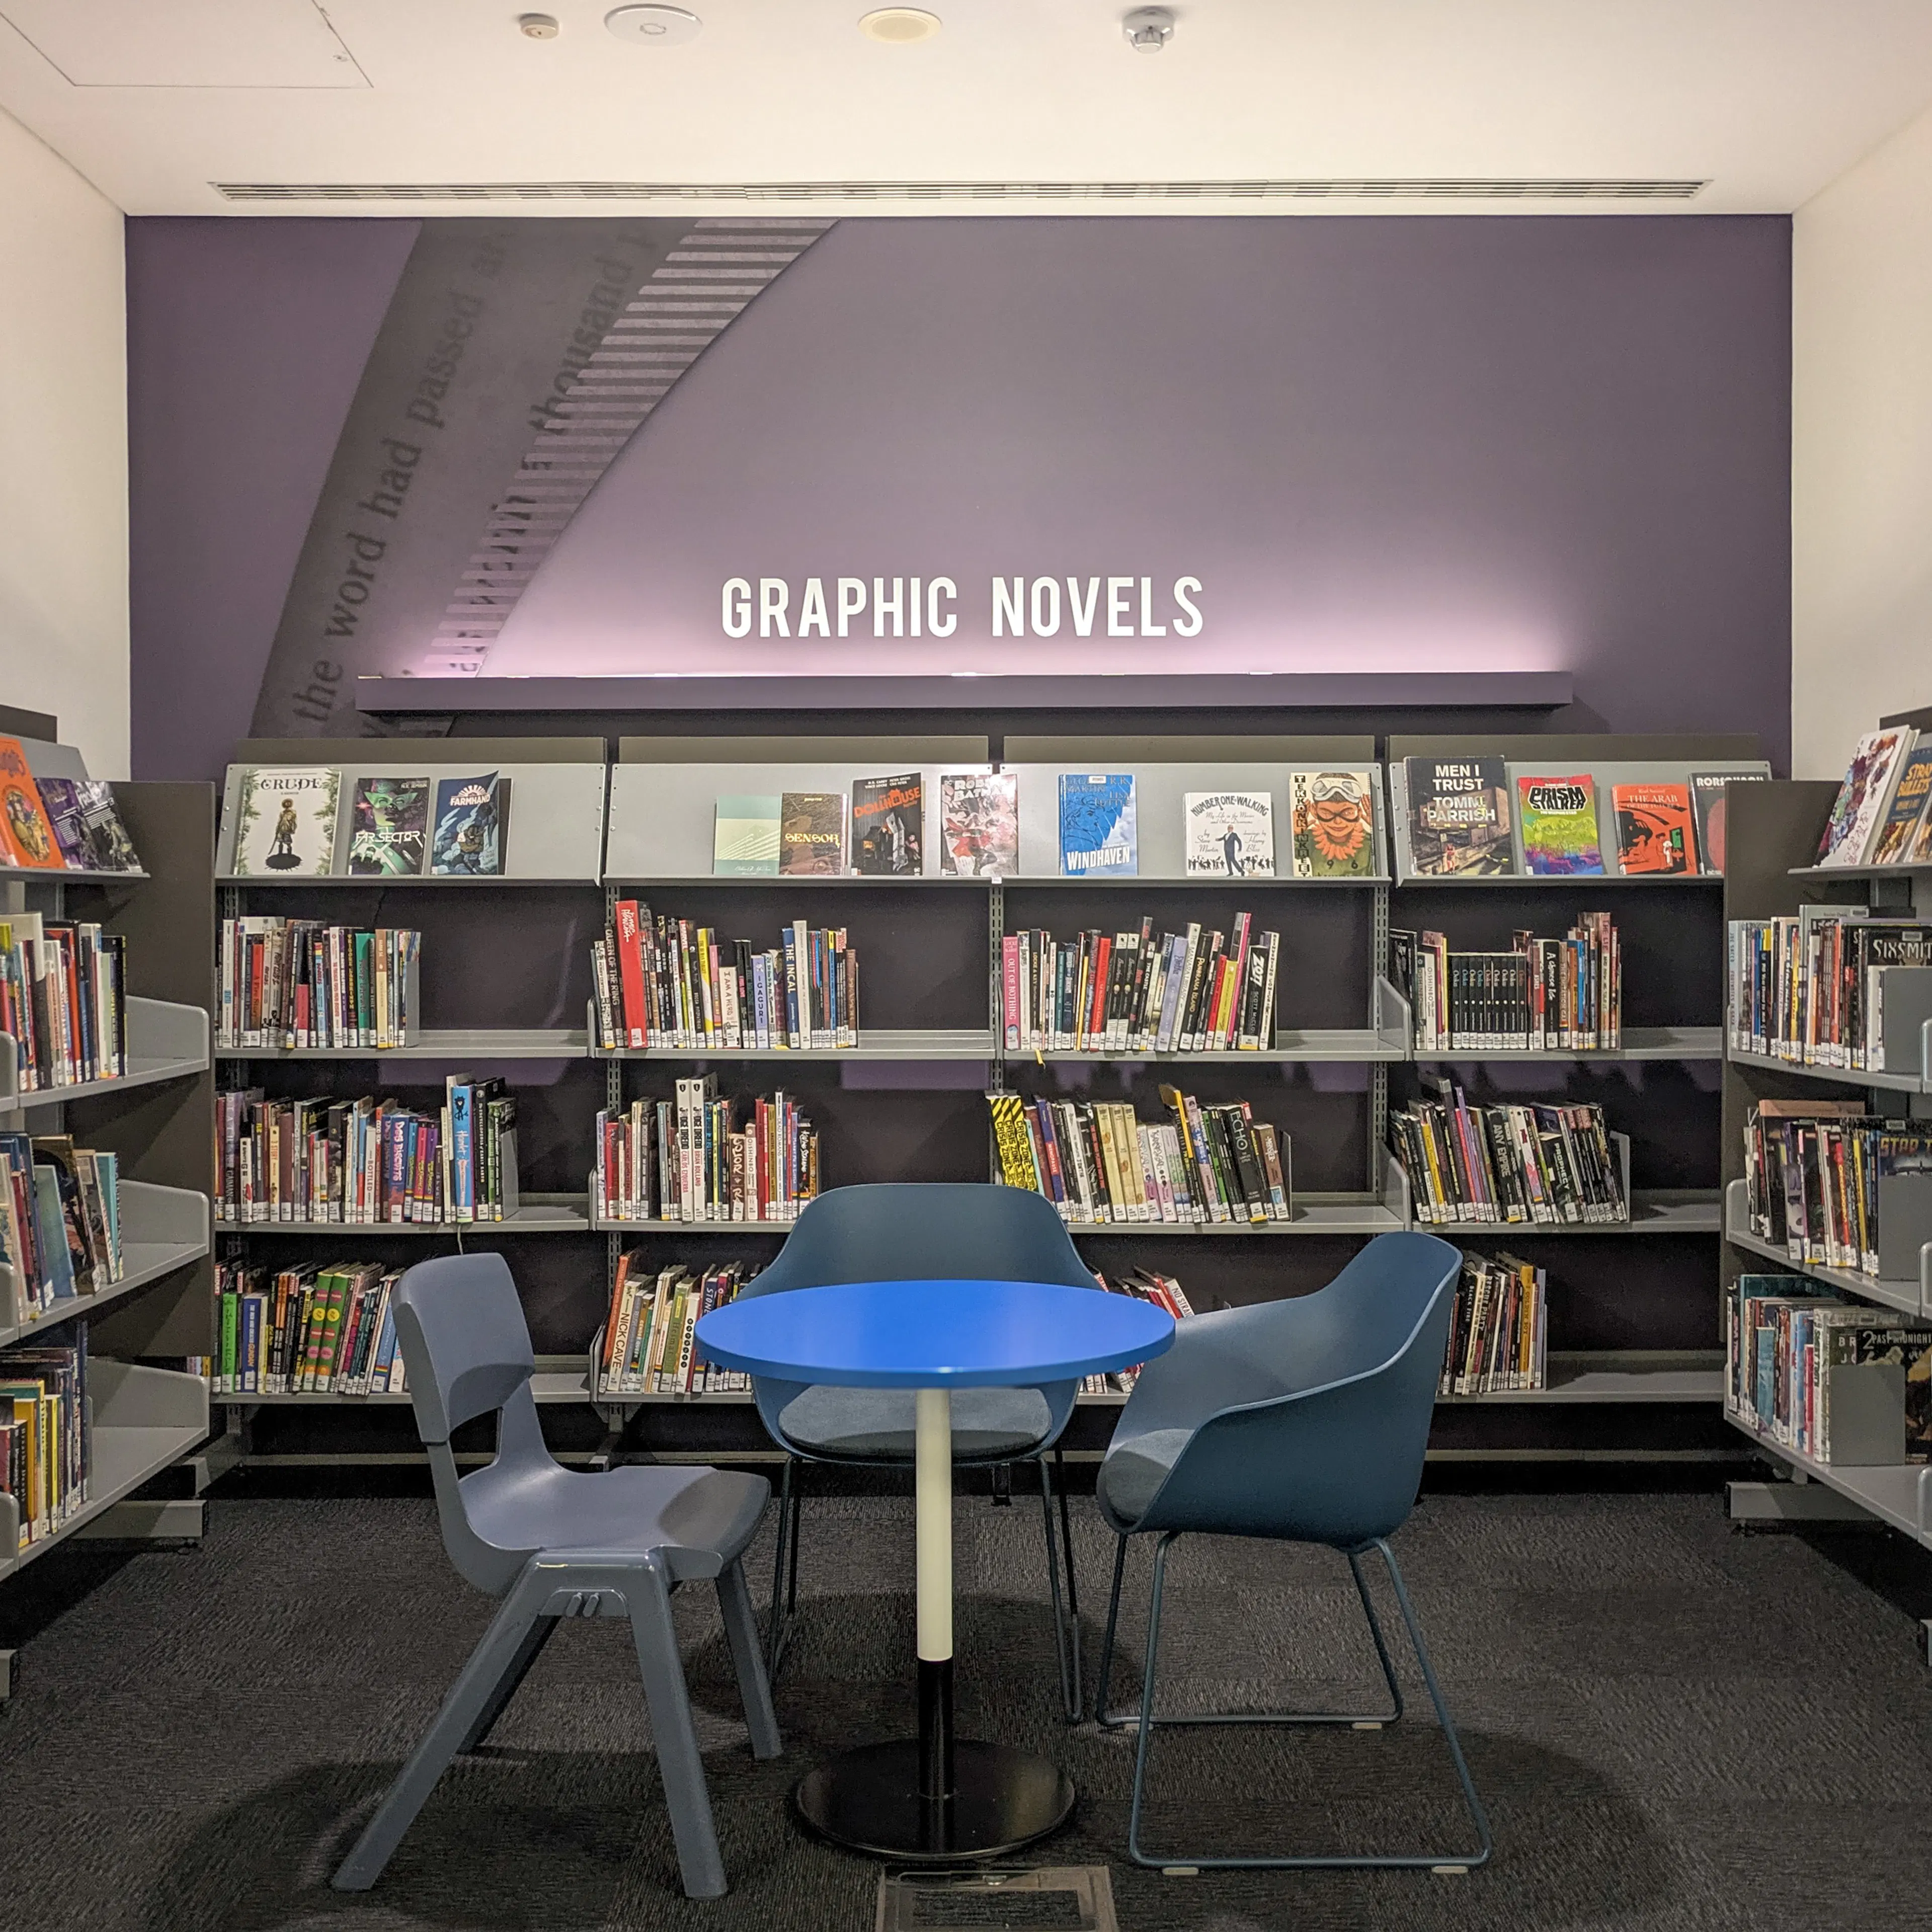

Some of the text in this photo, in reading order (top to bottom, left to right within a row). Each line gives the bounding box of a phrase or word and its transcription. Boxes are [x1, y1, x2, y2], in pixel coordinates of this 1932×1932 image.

[527, 253, 636, 435] thousand
[292, 659, 345, 722] the
[326, 532, 387, 640] word
[358, 437, 424, 521] had
[405, 290, 485, 431] passed
[721, 576, 1203, 638] GRAPHIC NOVELS
[1435, 764, 1480, 777] MEN I
[261, 778, 322, 790] CRUDE
[1432, 778, 1484, 791] TRUST
[1530, 787, 1586, 803] PRISM
[450, 794, 491, 806] FARMHAND
[1190, 795, 1269, 817] NUMBER ONE WALKING
[1533, 798, 1585, 810] STALKER
[1651, 794, 1678, 802] ARAB
[1427, 809, 1496, 822] PARRISH
[353, 831, 423, 848] FAR SECTOR
[784, 833, 841, 848] SENSOR
[1067, 846, 1131, 871] WINDHAVEN
[785, 944, 794, 960] THE
[1872, 936, 1932, 959] SIXSMIT
[605, 929, 620, 1005] QUEEN OF THE RING
[1185, 946, 1196, 974] MANARA
[725, 979, 732, 990] AM
[786, 963, 796, 994] INCAL
[1007, 958, 1016, 1020] OUT OF NOTHING
[1189, 957, 1205, 1013] PANORAMA ISLAND
[394, 1121, 405, 1143] DOG
[680, 1129, 690, 1149] DREDD
[693, 1128, 702, 1149] DREDD
[1230, 1111, 1248, 1150] ECHO
[454, 1130, 469, 1157] Hamlet
[996, 1121, 1011, 1167] CRISIS ZONE
[1006, 1120, 1020, 1165] CRISIS ZONE
[1016, 1120, 1031, 1167] CRISIS ZONE
[1265, 1136, 1278, 1162] MONSTER
[1493, 1124, 1511, 1178] ANY EMPIRE
[1880, 1137, 1919, 1157] STAR
[681, 1150, 689, 1168] CARLOS
[1048, 1144, 1057, 1173] MENOPAUSE
[1554, 1142, 1570, 1189] PROPHECY
[704, 1287, 714, 1315] STONE
[1172, 1287, 1181, 1298] NO
[1467, 1285, 1475, 1306] BLACK
[1479, 1275, 1493, 1332] RESCUE PARTY
[618, 1313, 630, 1336] NICK
[1862, 1330, 1875, 1349] 2
[247, 1343, 255, 1367] GUNDAM
[612, 1336, 624, 1368] CAVE
